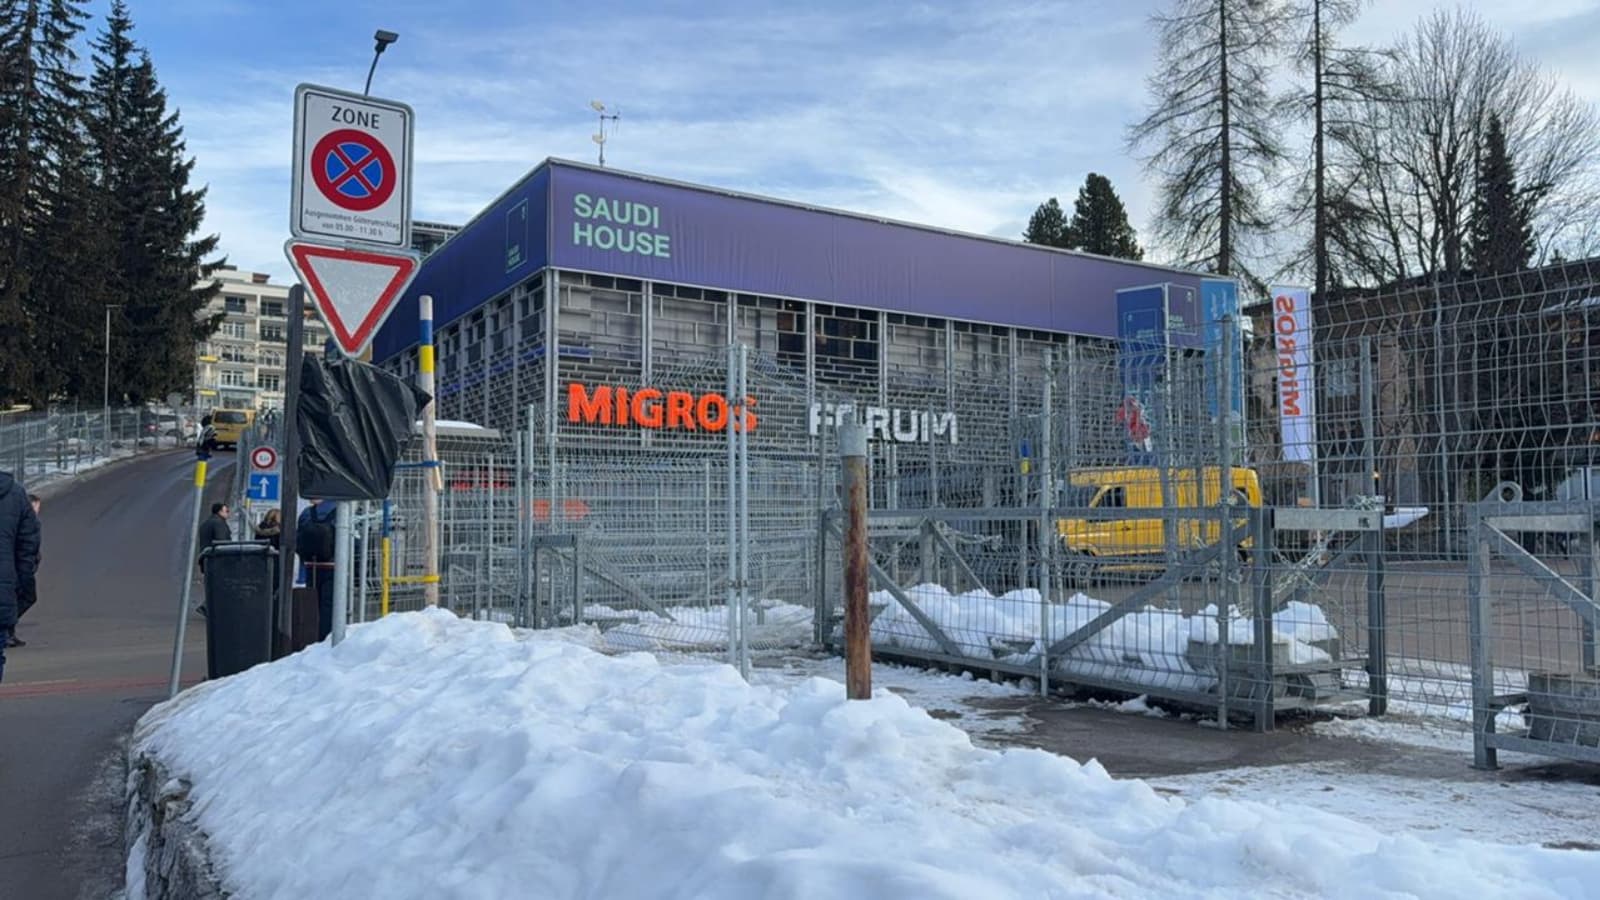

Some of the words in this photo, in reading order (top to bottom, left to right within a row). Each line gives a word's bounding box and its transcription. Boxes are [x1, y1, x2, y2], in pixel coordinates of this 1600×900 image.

[332, 105, 380, 129] ZONE
[573, 193, 659, 229] SAUDI
[573, 222, 671, 258] HOUSE
[567, 383, 758, 432] MIGROS
